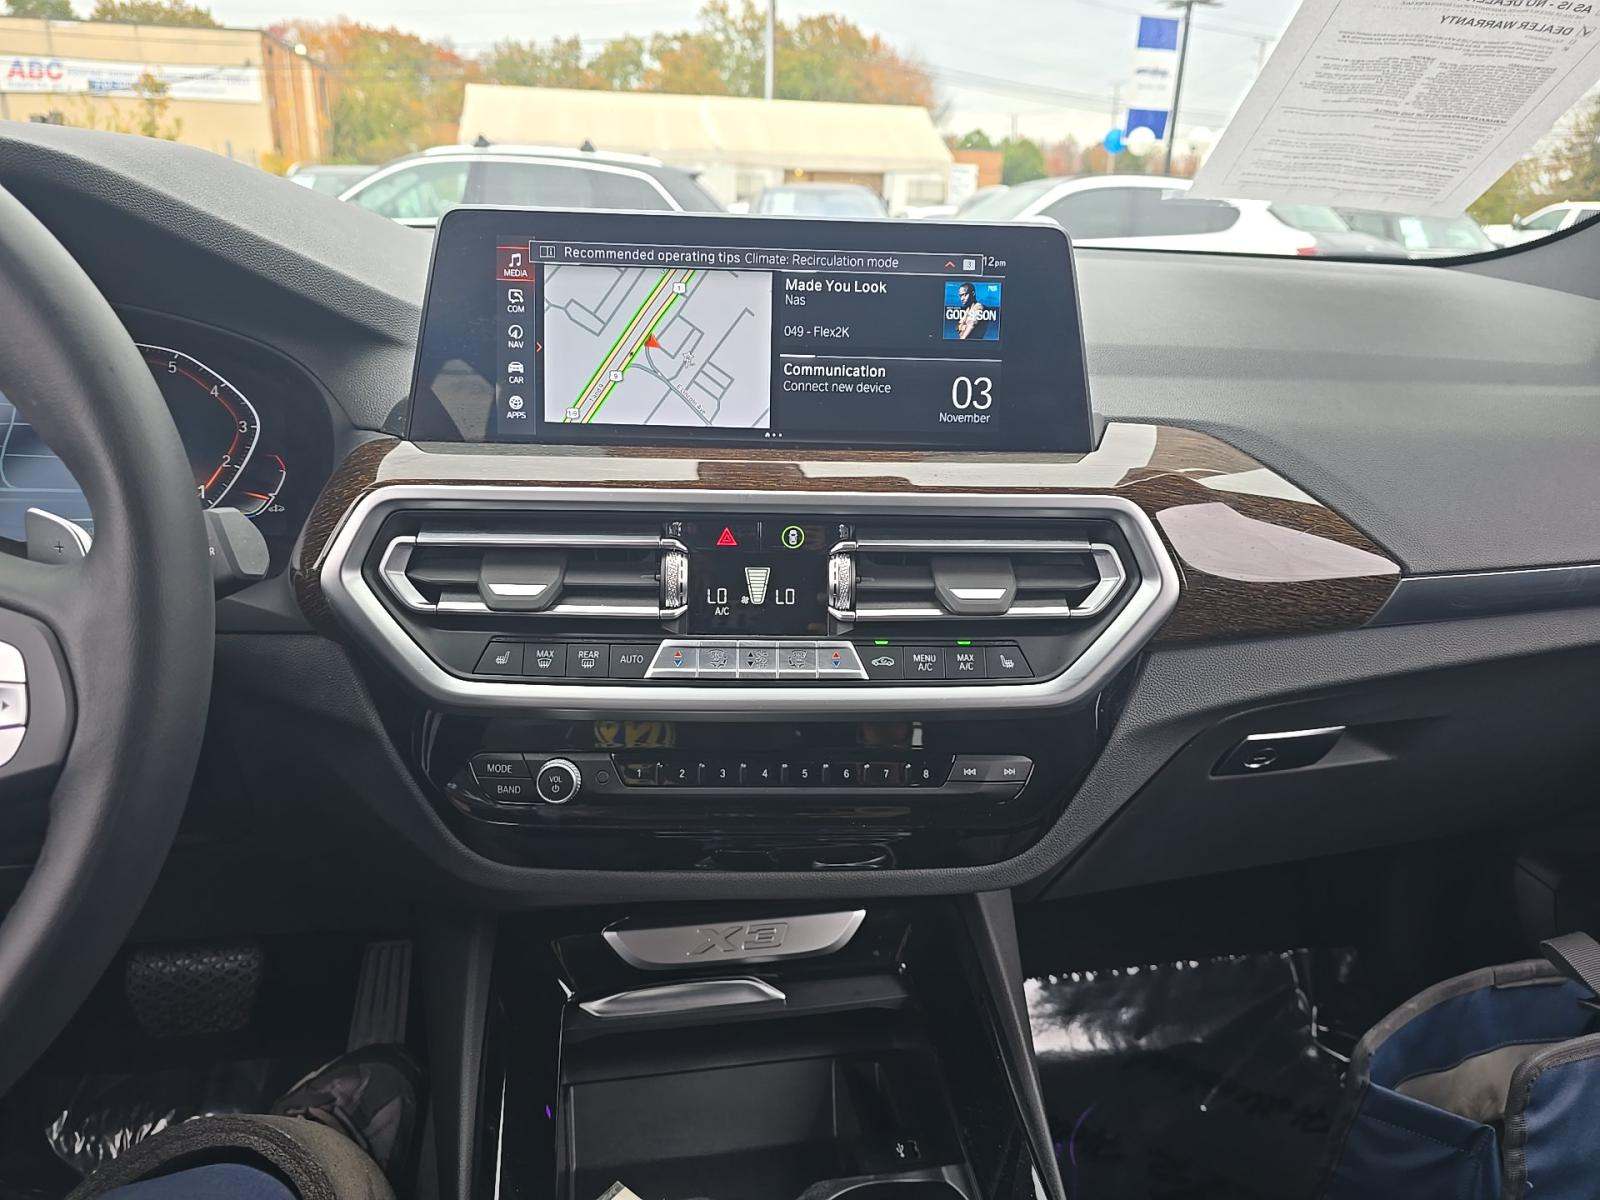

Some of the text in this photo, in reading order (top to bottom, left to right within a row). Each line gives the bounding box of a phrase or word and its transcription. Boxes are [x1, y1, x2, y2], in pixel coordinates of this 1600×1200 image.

[7, 57, 64, 80] ABC
[564, 246, 899, 269] Recommended operating tips Climate: Recirculation mode
[503, 268, 528, 278] MEDIA
[785, 278, 887, 293] Made You Look
[785, 294, 806, 306] Nas
[507, 304, 525, 313] COM
[784, 325, 804, 337] 049
[813, 326, 850, 338] Flex2K
[508, 340, 524, 349] NAV
[167, 360, 177, 373] 5
[783, 362, 886, 378] Communication
[508, 375, 524, 384] CAR
[210, 385, 220, 397] 4
[783, 380, 891, 393] Connect new device
[951, 375, 993, 410] 03
[506, 410, 526, 420] APPS
[938, 412, 991, 423] November
[238, 420, 248, 433] 3
[222, 455, 231, 468] 2
[197, 484, 205, 499] 1
[208, 546, 216, 557] R
[707, 587, 727, 605] LO
[775, 588, 795, 605] LO
[714, 606, 730, 616] A/C
[536, 650, 554, 659] MAX
[578, 650, 600, 659] REAR
[620, 654, 644, 664] AUTO
[913, 654, 936, 663] MENU
[956, 653, 974, 662] MAX
[917, 662, 933, 671] A/C
[958, 662, 974, 671] A/C
[486, 763, 513, 774] MODE
[636, 768, 642, 779] 1
[679, 768, 685, 779] 2
[719, 768, 726, 779] 3
[762, 768, 768, 779] 4
[801, 768, 808, 779] 5
[843, 768, 850, 779] 6
[883, 768, 890, 779] 7
[922, 768, 929, 779] 8
[549, 775, 563, 784] VOL
[497, 785, 521, 795] BAND
[693, 921, 789, 955] X3
